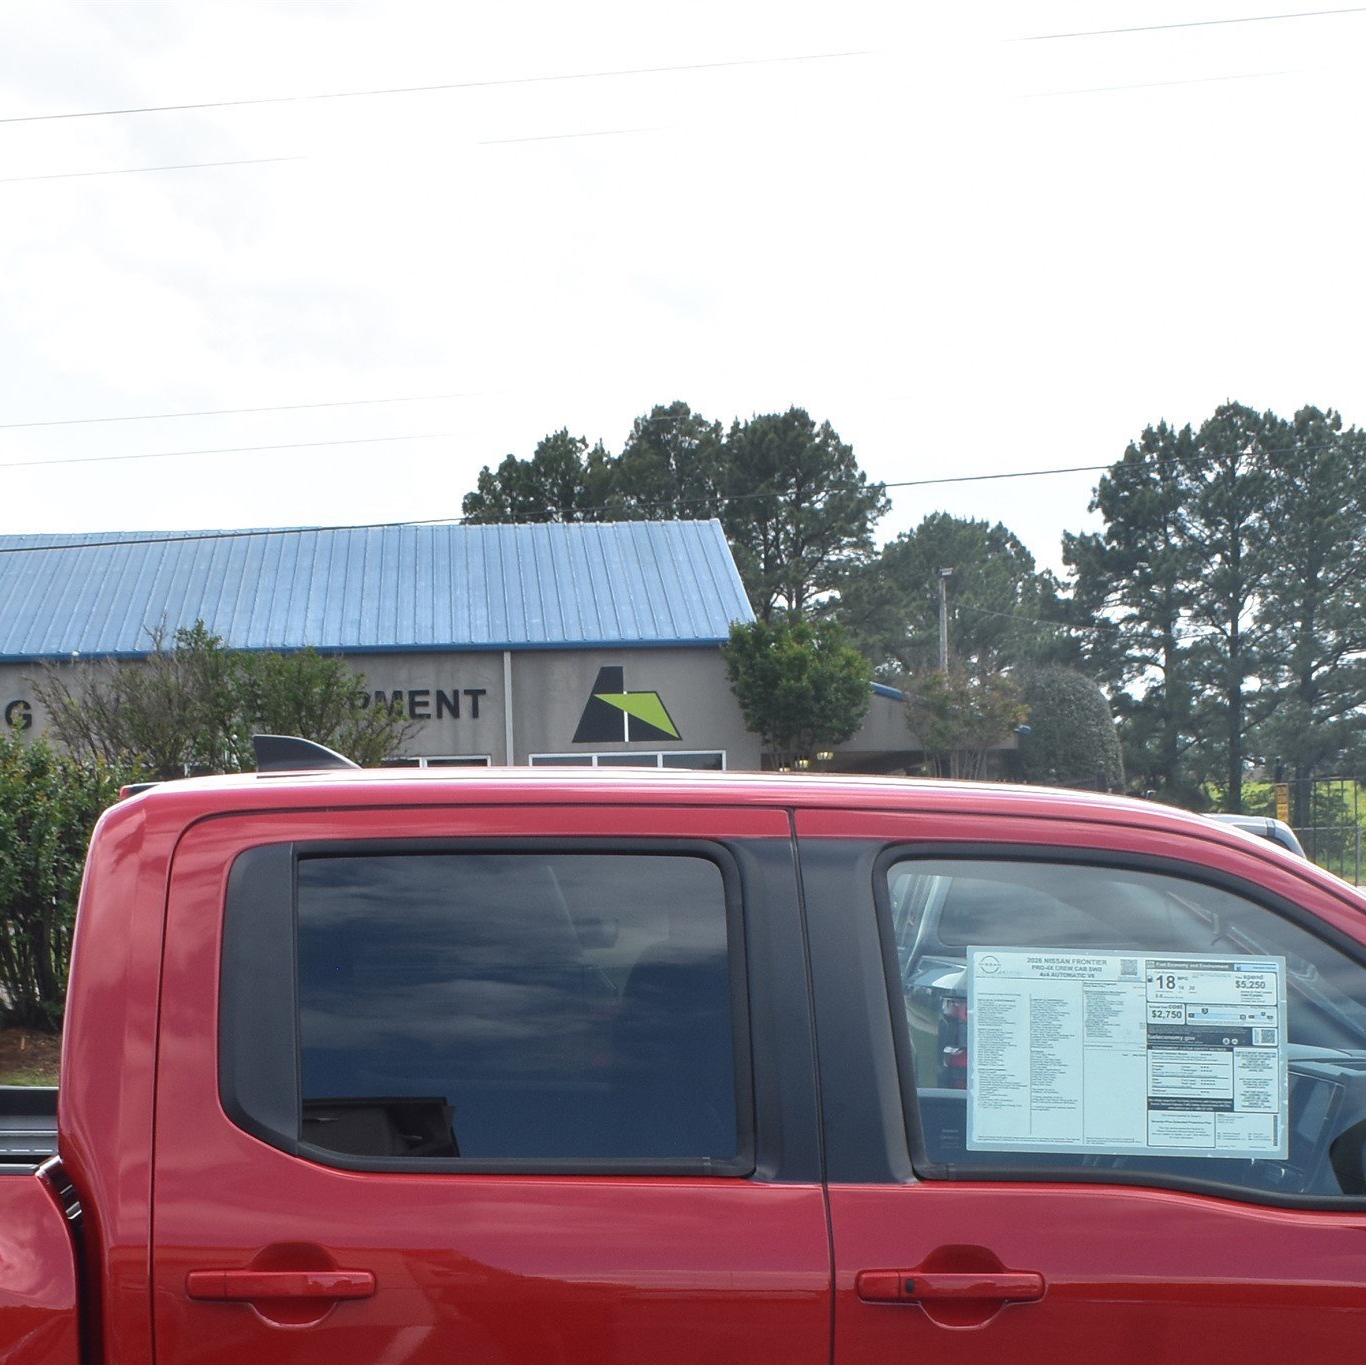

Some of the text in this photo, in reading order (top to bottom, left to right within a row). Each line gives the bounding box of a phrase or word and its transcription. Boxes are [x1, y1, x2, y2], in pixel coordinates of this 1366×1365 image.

[1156, 975, 1175, 989] 18
[1235, 981, 1266, 990] $5,250
[1152, 1010, 1182, 1019] $2,750
